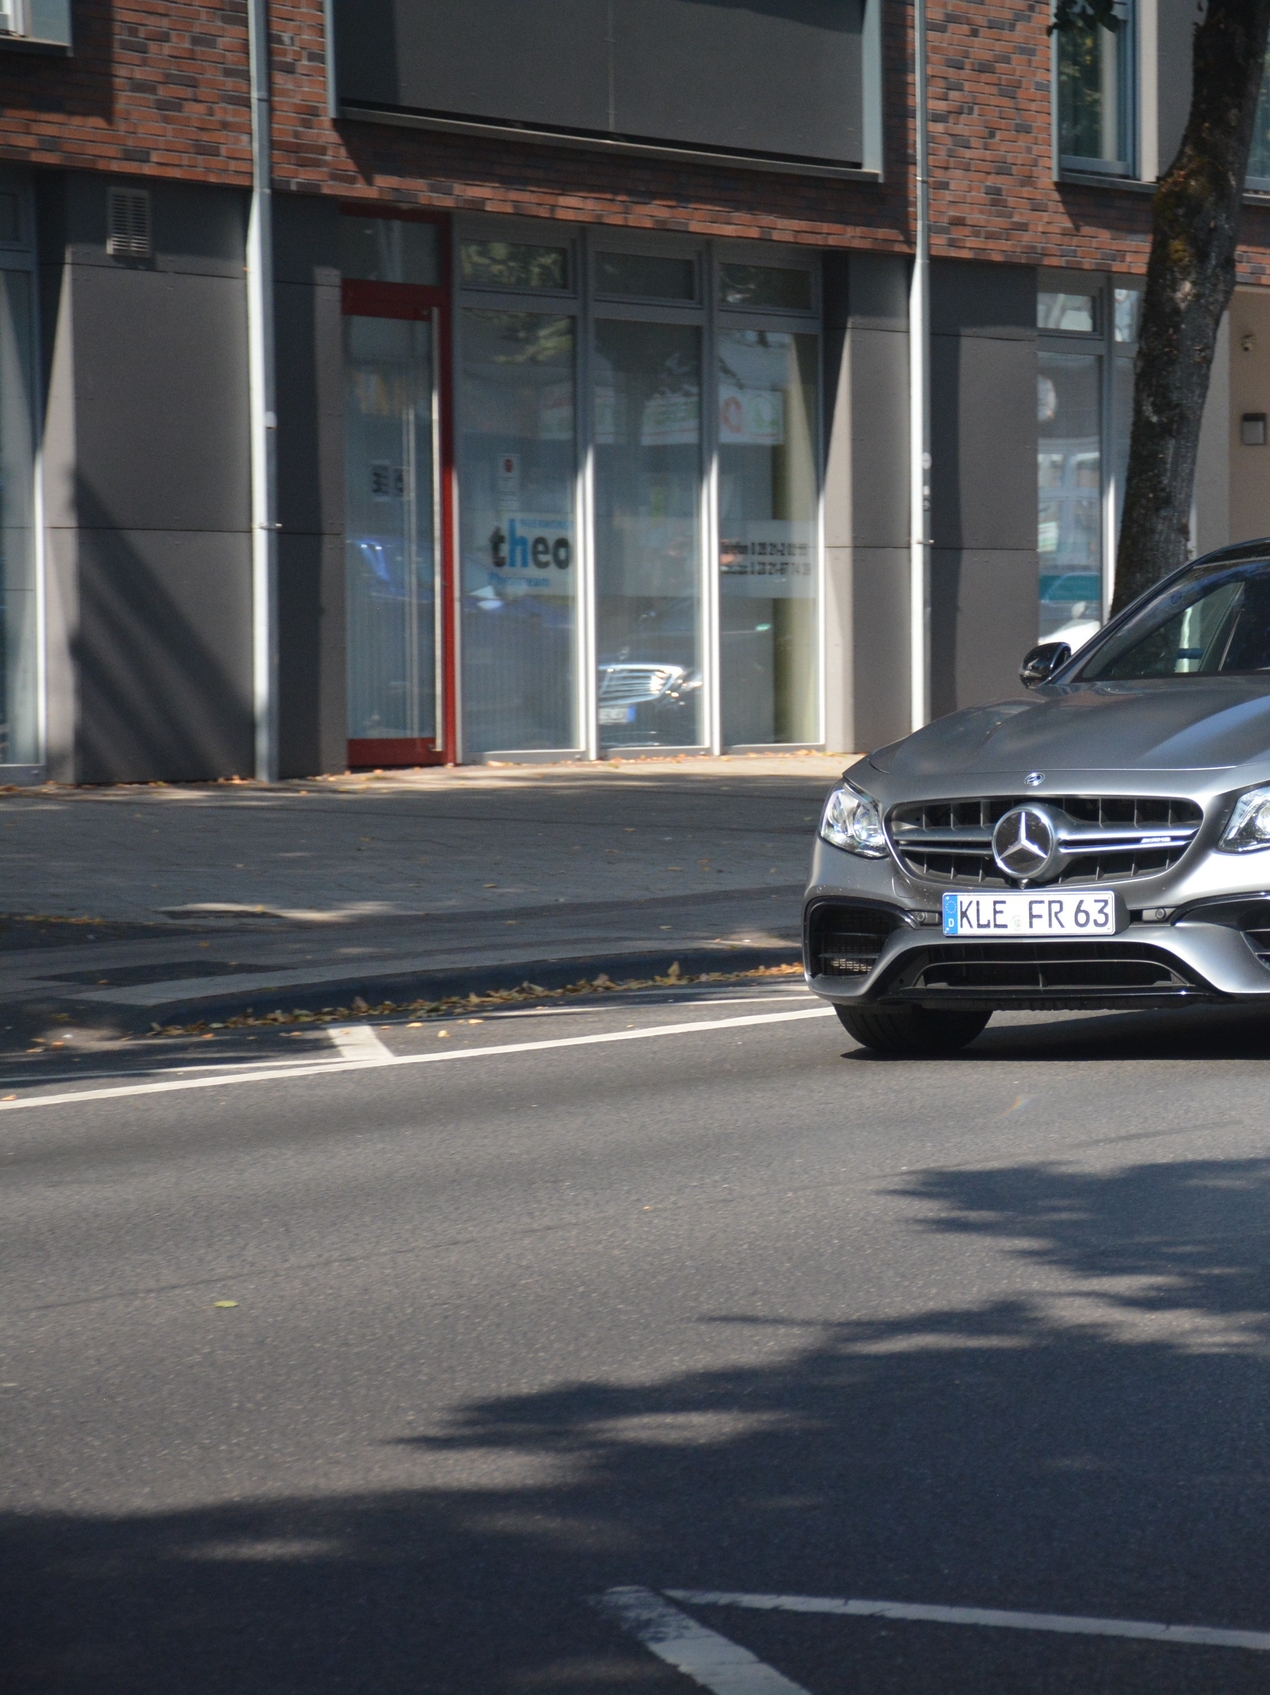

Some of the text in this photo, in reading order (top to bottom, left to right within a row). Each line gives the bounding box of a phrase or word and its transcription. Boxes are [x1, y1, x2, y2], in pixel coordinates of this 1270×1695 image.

[490, 518, 571, 570] theo
[948, 918, 955, 927] D
[959, 899, 1110, 929] KLE FR 63
